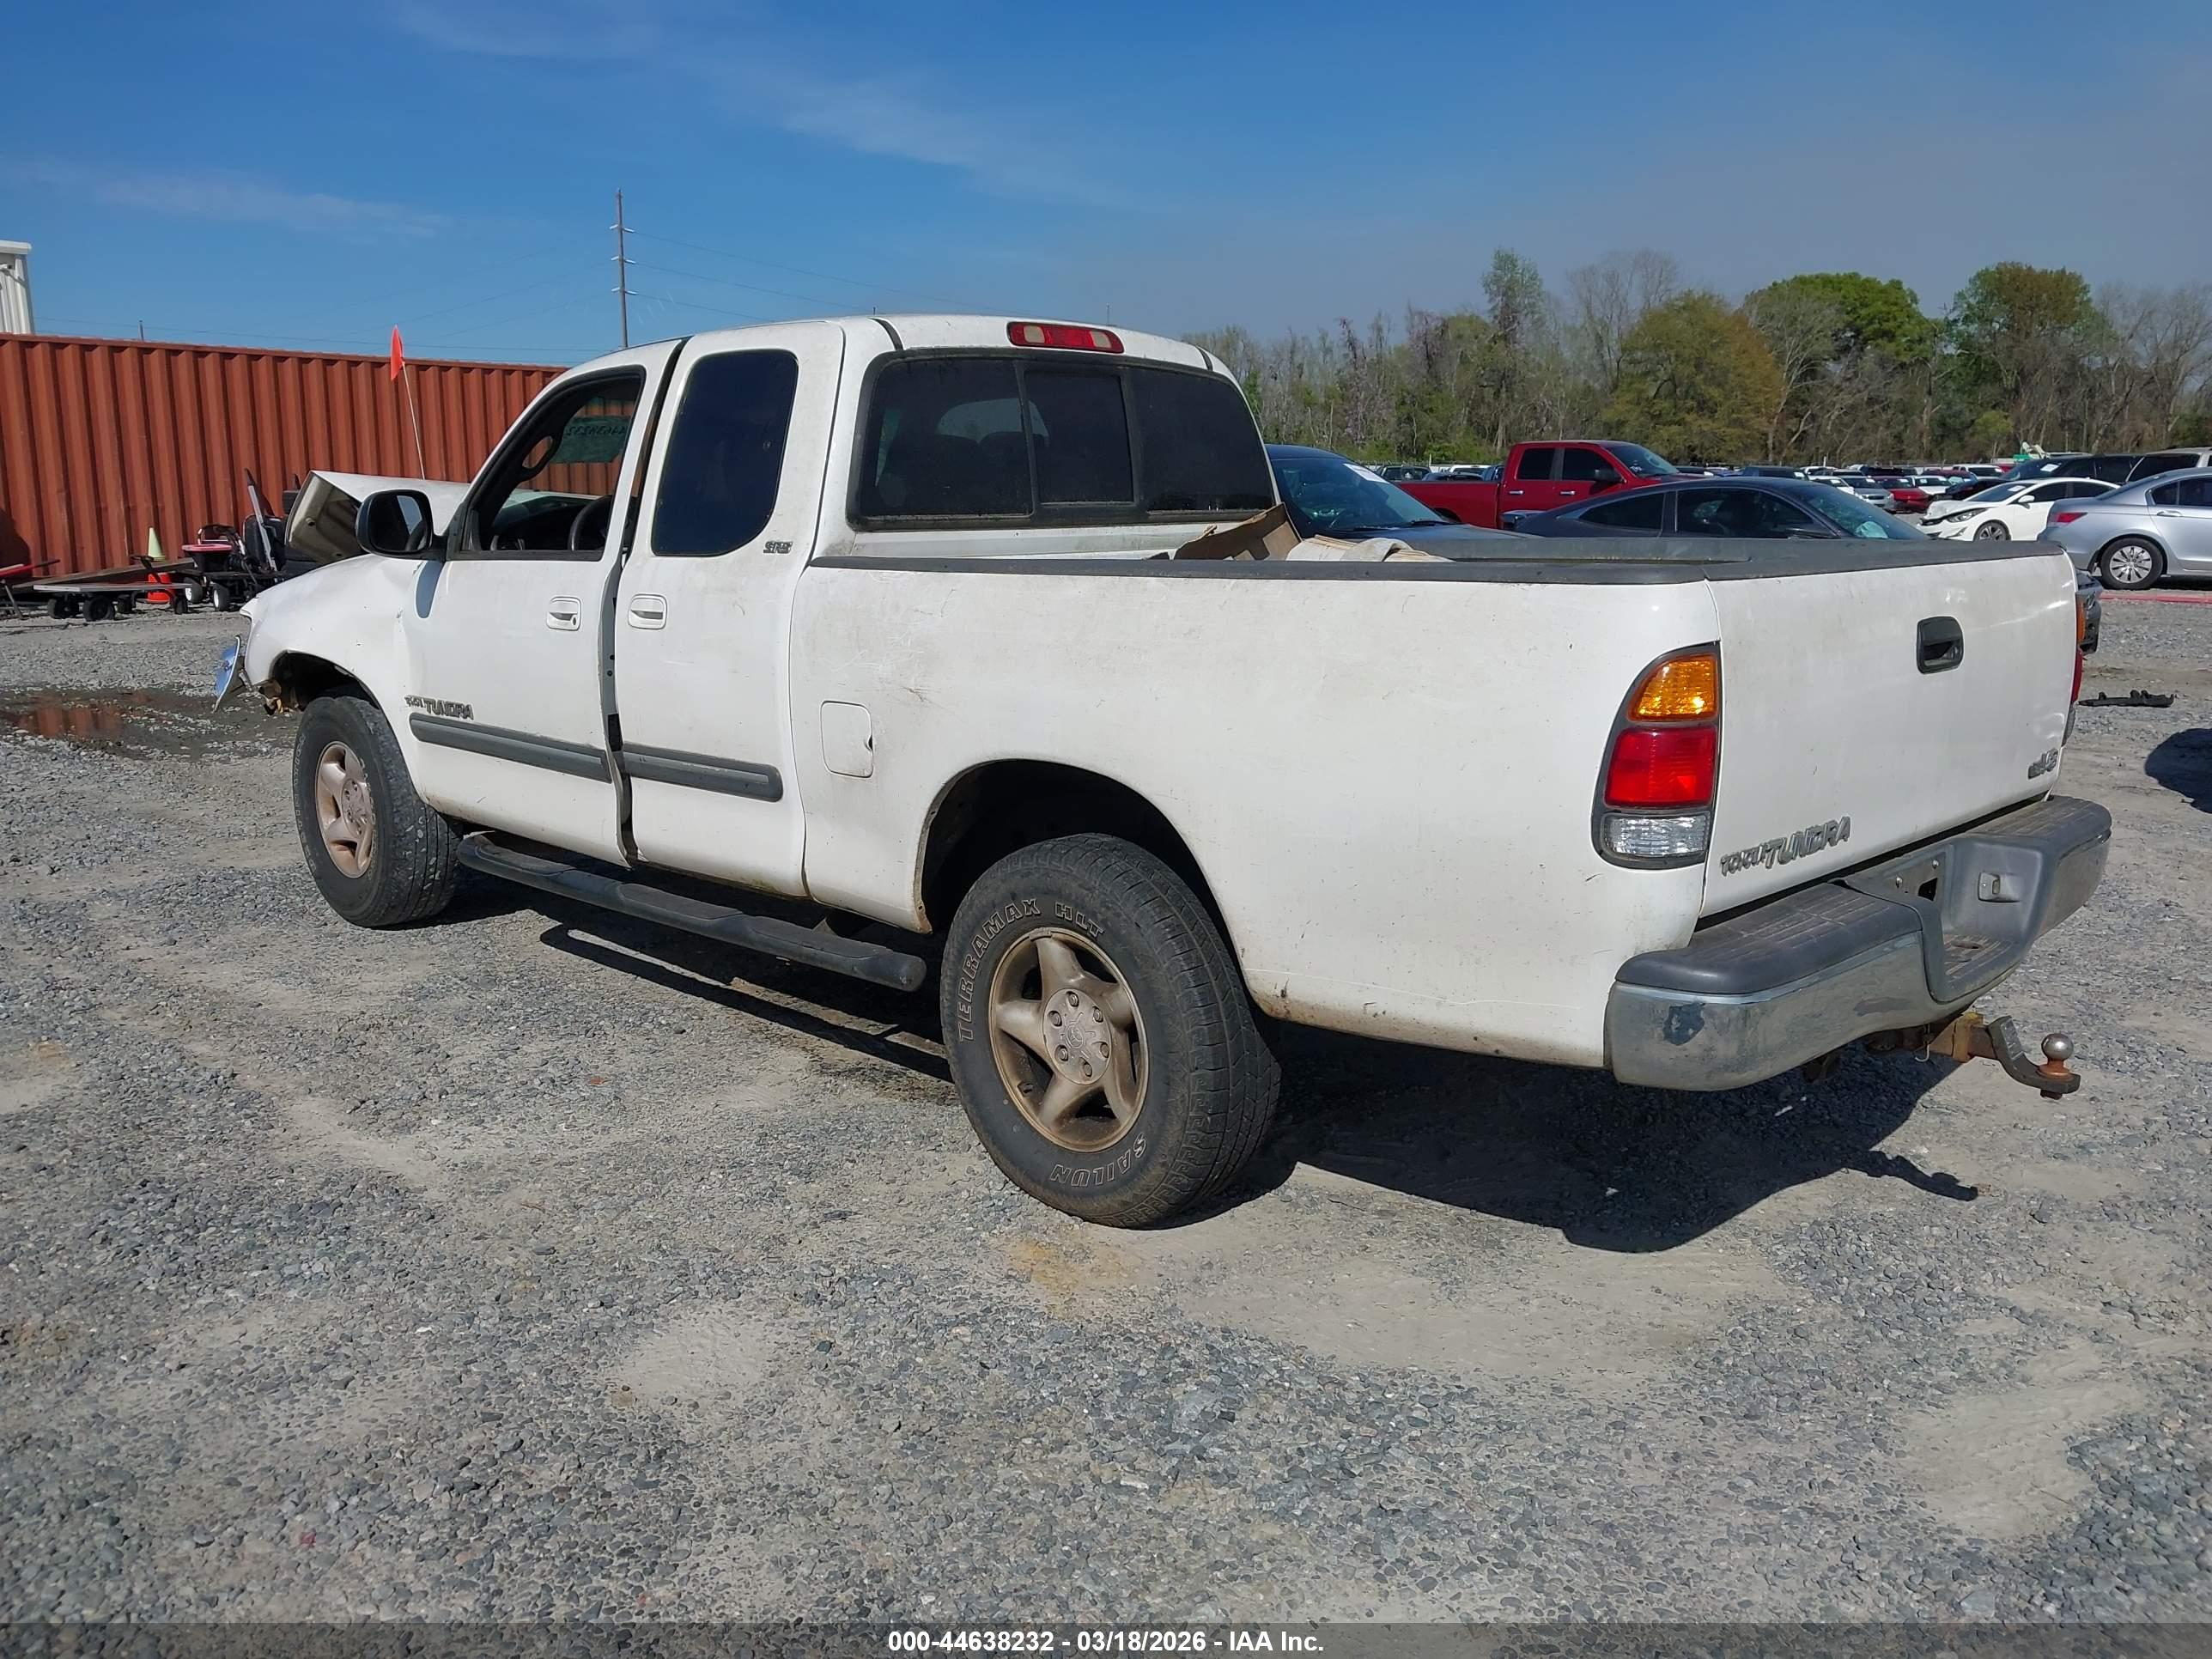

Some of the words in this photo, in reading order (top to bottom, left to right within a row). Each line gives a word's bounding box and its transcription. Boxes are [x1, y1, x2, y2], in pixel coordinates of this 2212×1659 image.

[423, 697, 474, 720] TUNDRA
[1762, 816, 1851, 870] TUNDRA
[957, 897, 1042, 1042] TERRAMAX
[1054, 902, 1105, 938] HLT
[1049, 1132, 1147, 1188] SAILUN
